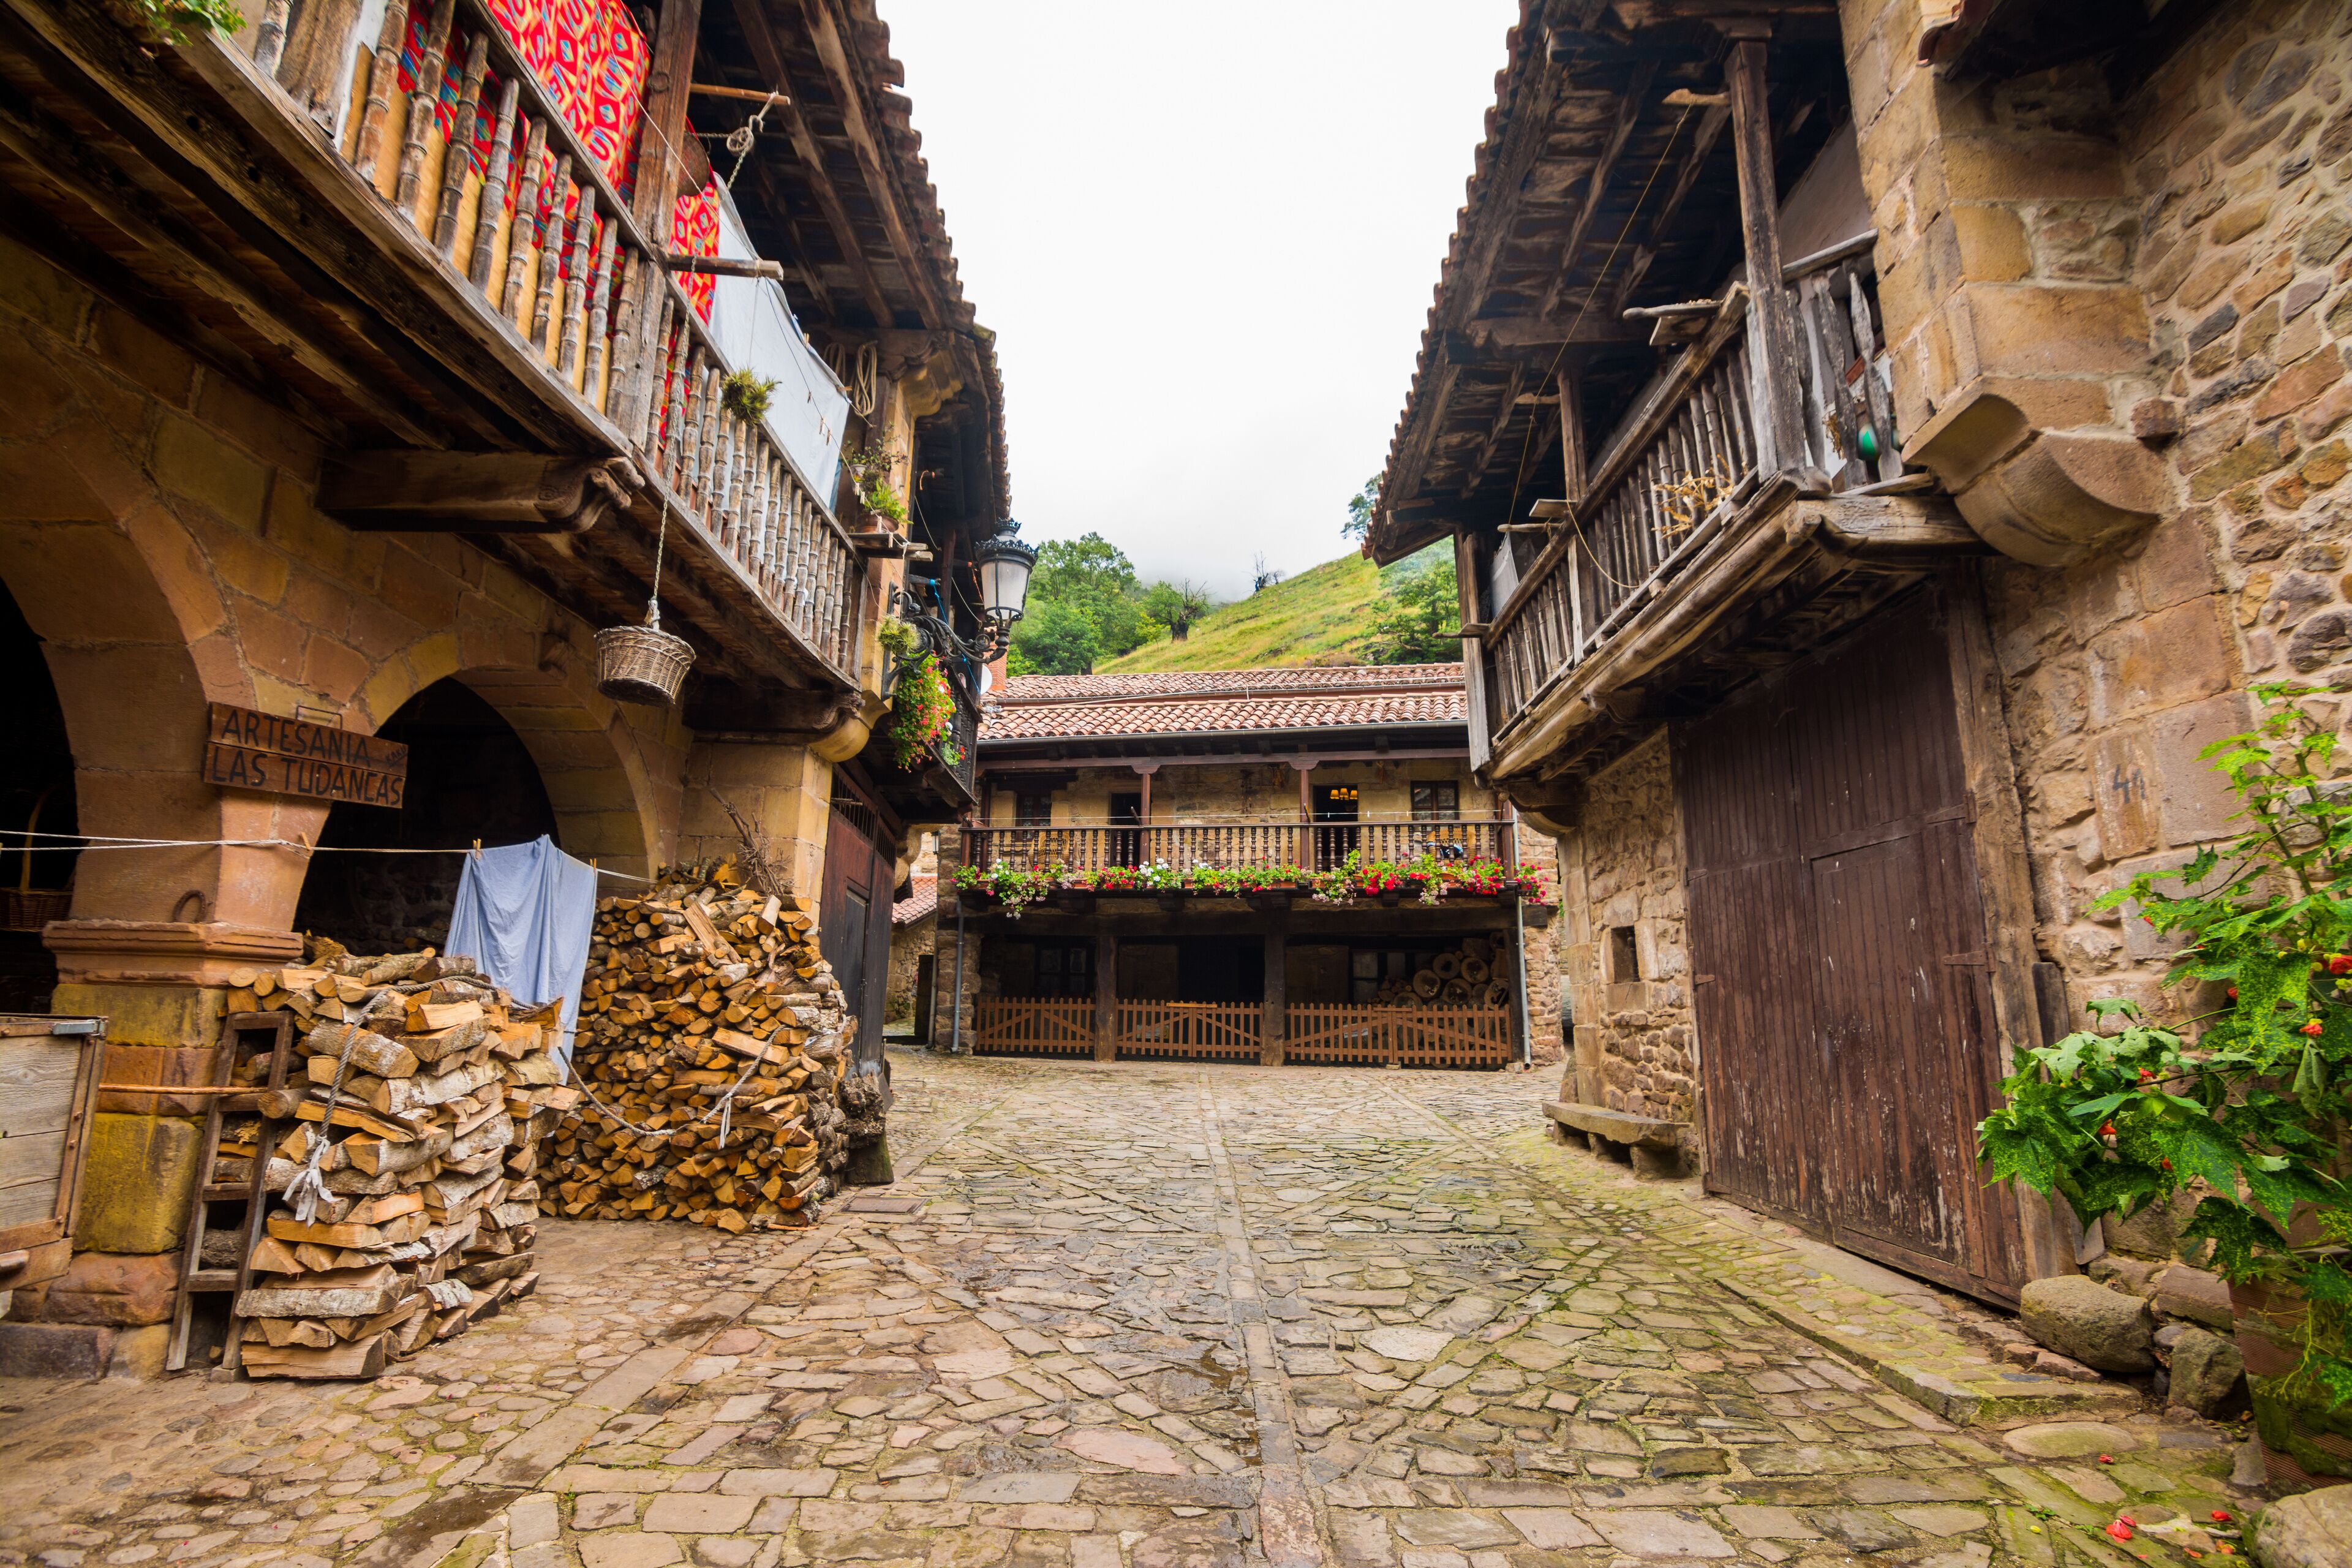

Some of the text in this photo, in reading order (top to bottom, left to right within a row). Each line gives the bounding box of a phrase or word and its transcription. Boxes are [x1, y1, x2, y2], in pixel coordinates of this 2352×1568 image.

[222, 709, 371, 767] ARTESANIA
[213, 746, 402, 805] LAS TUDANCAS
[2112, 764, 2145, 804] 41
